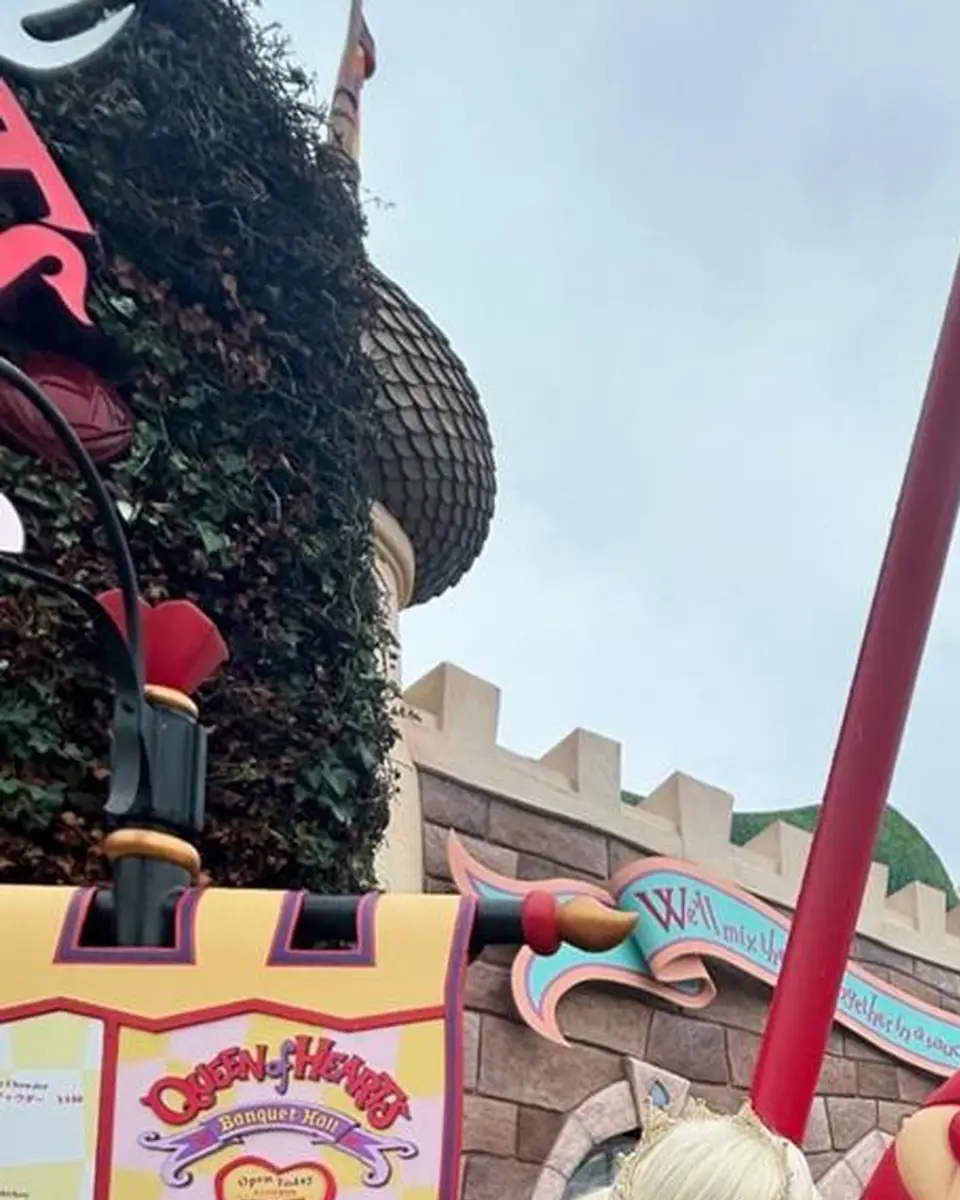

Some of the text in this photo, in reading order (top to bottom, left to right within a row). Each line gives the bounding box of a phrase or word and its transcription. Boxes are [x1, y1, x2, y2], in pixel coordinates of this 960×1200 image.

[634, 886, 721, 937] We'll
[139, 1034, 412, 1131] QUEEN of HEARTS
[217, 1107, 340, 1134] Banquet Hall
